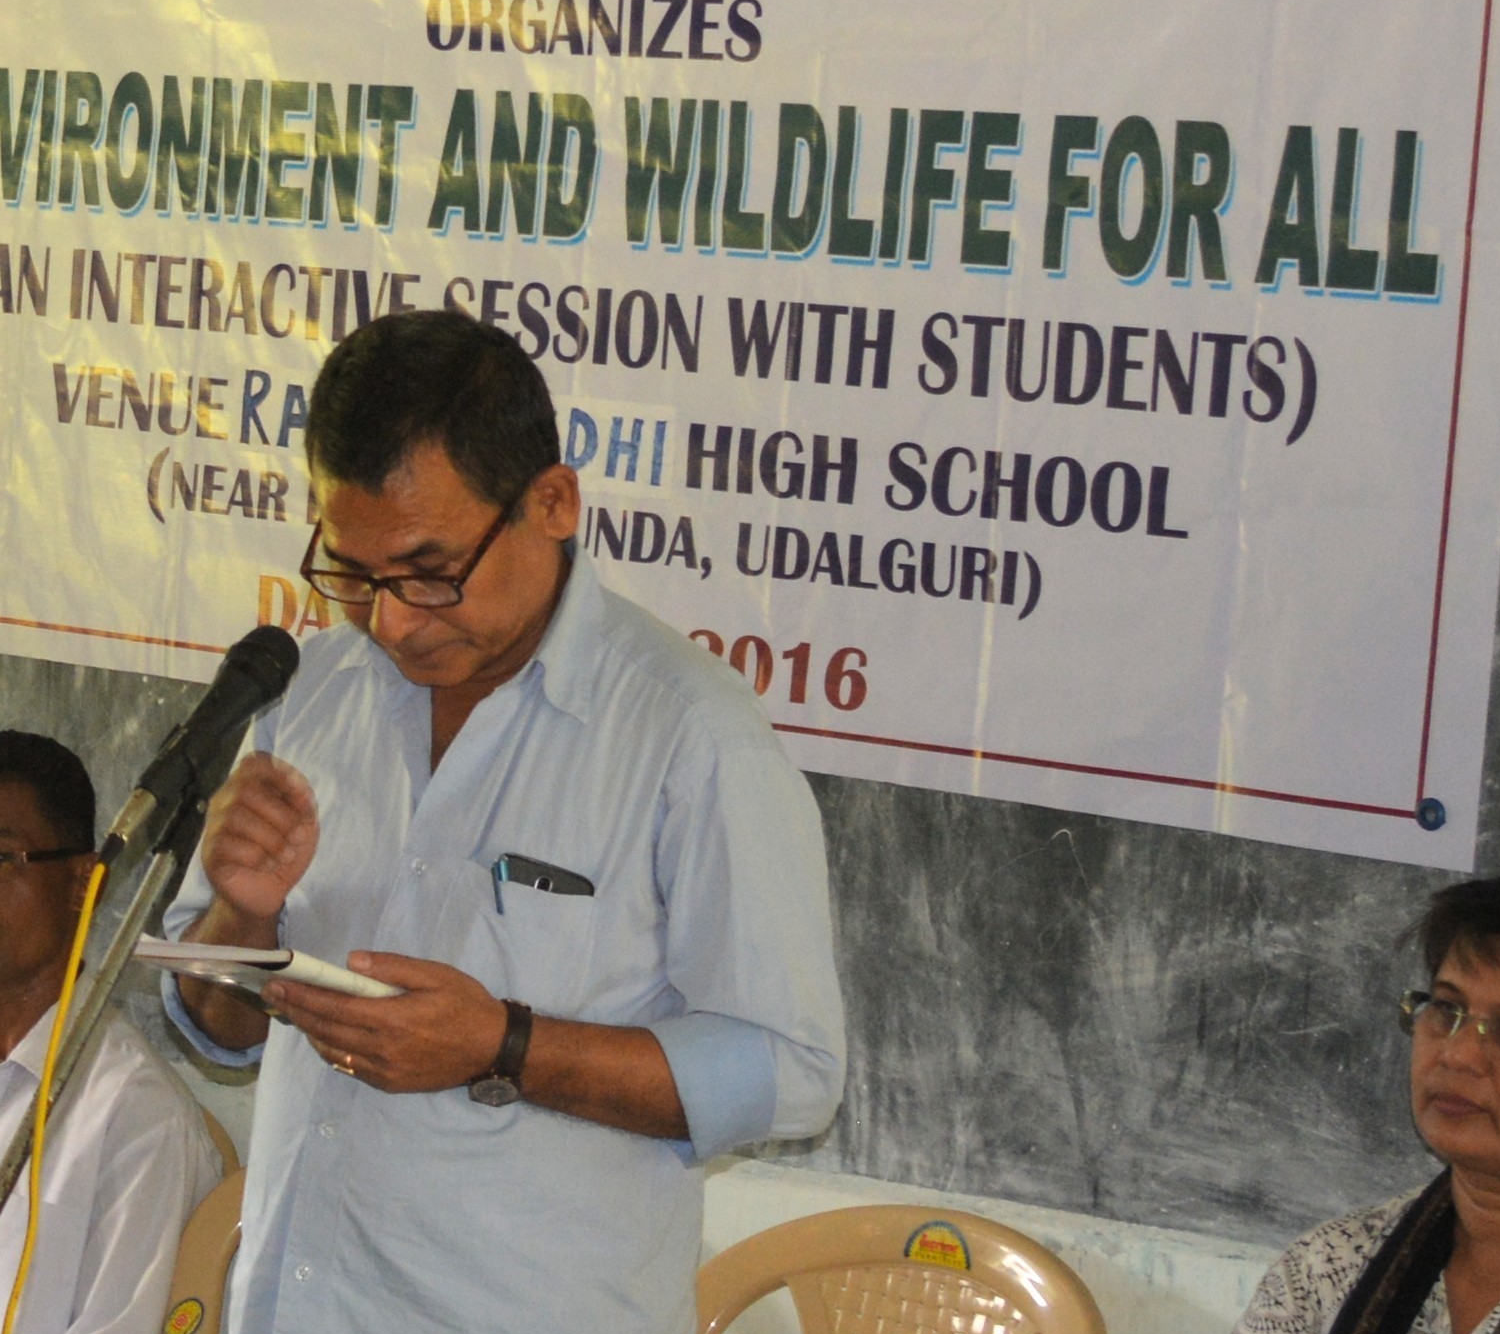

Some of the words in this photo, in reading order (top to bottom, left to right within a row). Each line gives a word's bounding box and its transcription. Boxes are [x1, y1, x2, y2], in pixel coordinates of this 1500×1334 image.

[428, 88, 602, 244] AND
[624, 95, 1022, 271] WILDLIFE
[1042, 114, 1238, 287] FOR
[1255, 124, 1442, 304] ALL
[53, 362, 229, 444] VENUE
[239, 368, 312, 449] RA
[563, 406, 668, 488] DHI
[685, 422, 858, 505] HIGH
[883, 440, 1190, 539] SCHOOL
[727, 293, 896, 390] WITH
[917, 311, 1317, 446] STUDENTS)
[147, 446, 290, 525] (NEAR
[584, 504, 713, 581] NDA,
[735, 521, 1043, 620] UDALGURI)
[257, 573, 331, 638] DA
